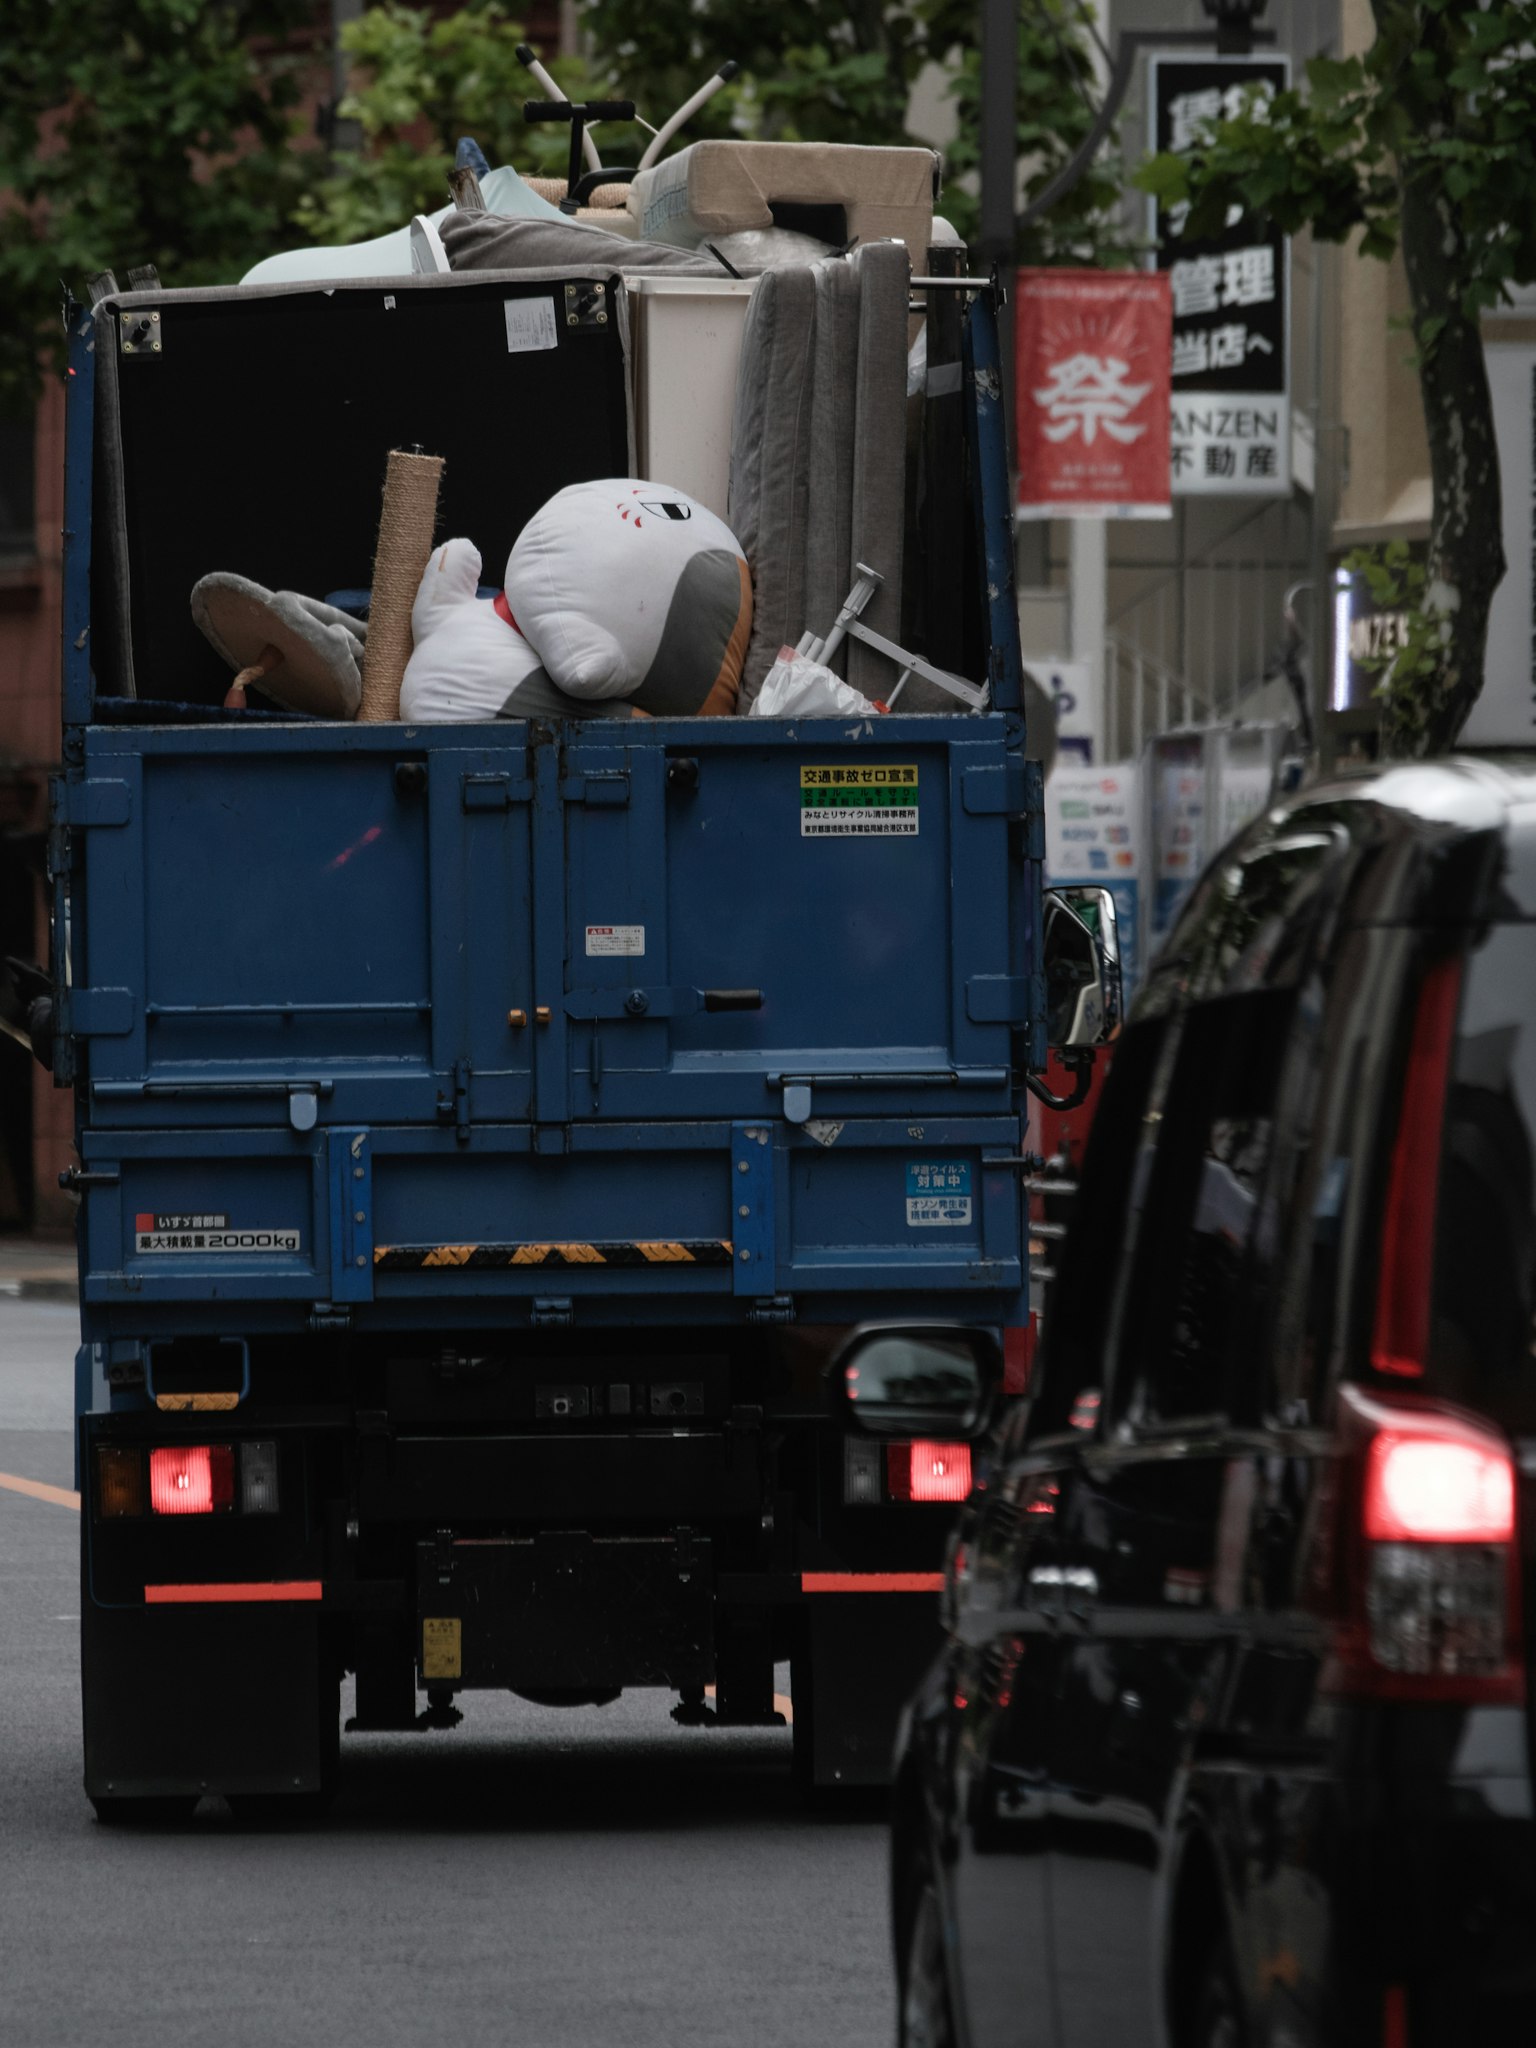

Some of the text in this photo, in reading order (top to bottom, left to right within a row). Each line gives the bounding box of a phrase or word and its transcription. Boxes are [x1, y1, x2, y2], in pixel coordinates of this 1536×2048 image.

[1172, 245, 1275, 317] 管理
[1172, 323, 1275, 376] 当店へ
[1033, 354, 1152, 446] 祭
[1171, 446, 1277, 477] 不動産
[804, 769, 915, 784] 交通事故ゼロ宣言
[804, 810, 916, 820] みなとリサイクル清掃事務所
[917, 1174, 961, 1188] 対策中
